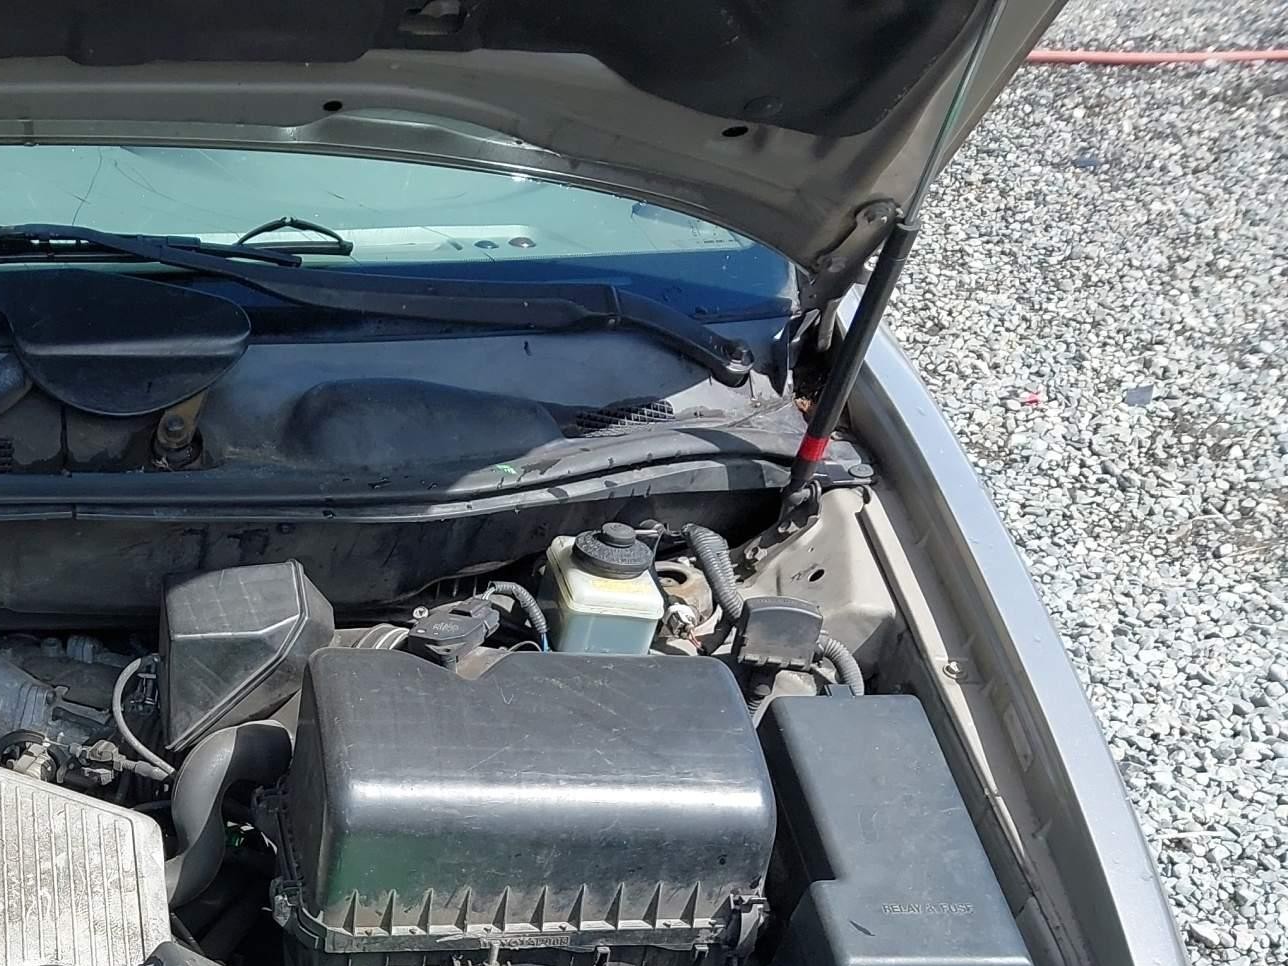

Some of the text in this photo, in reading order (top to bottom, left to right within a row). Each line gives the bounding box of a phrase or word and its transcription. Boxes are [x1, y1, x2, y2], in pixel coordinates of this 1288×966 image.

[882, 902, 975, 914] RELAY & FUSE
